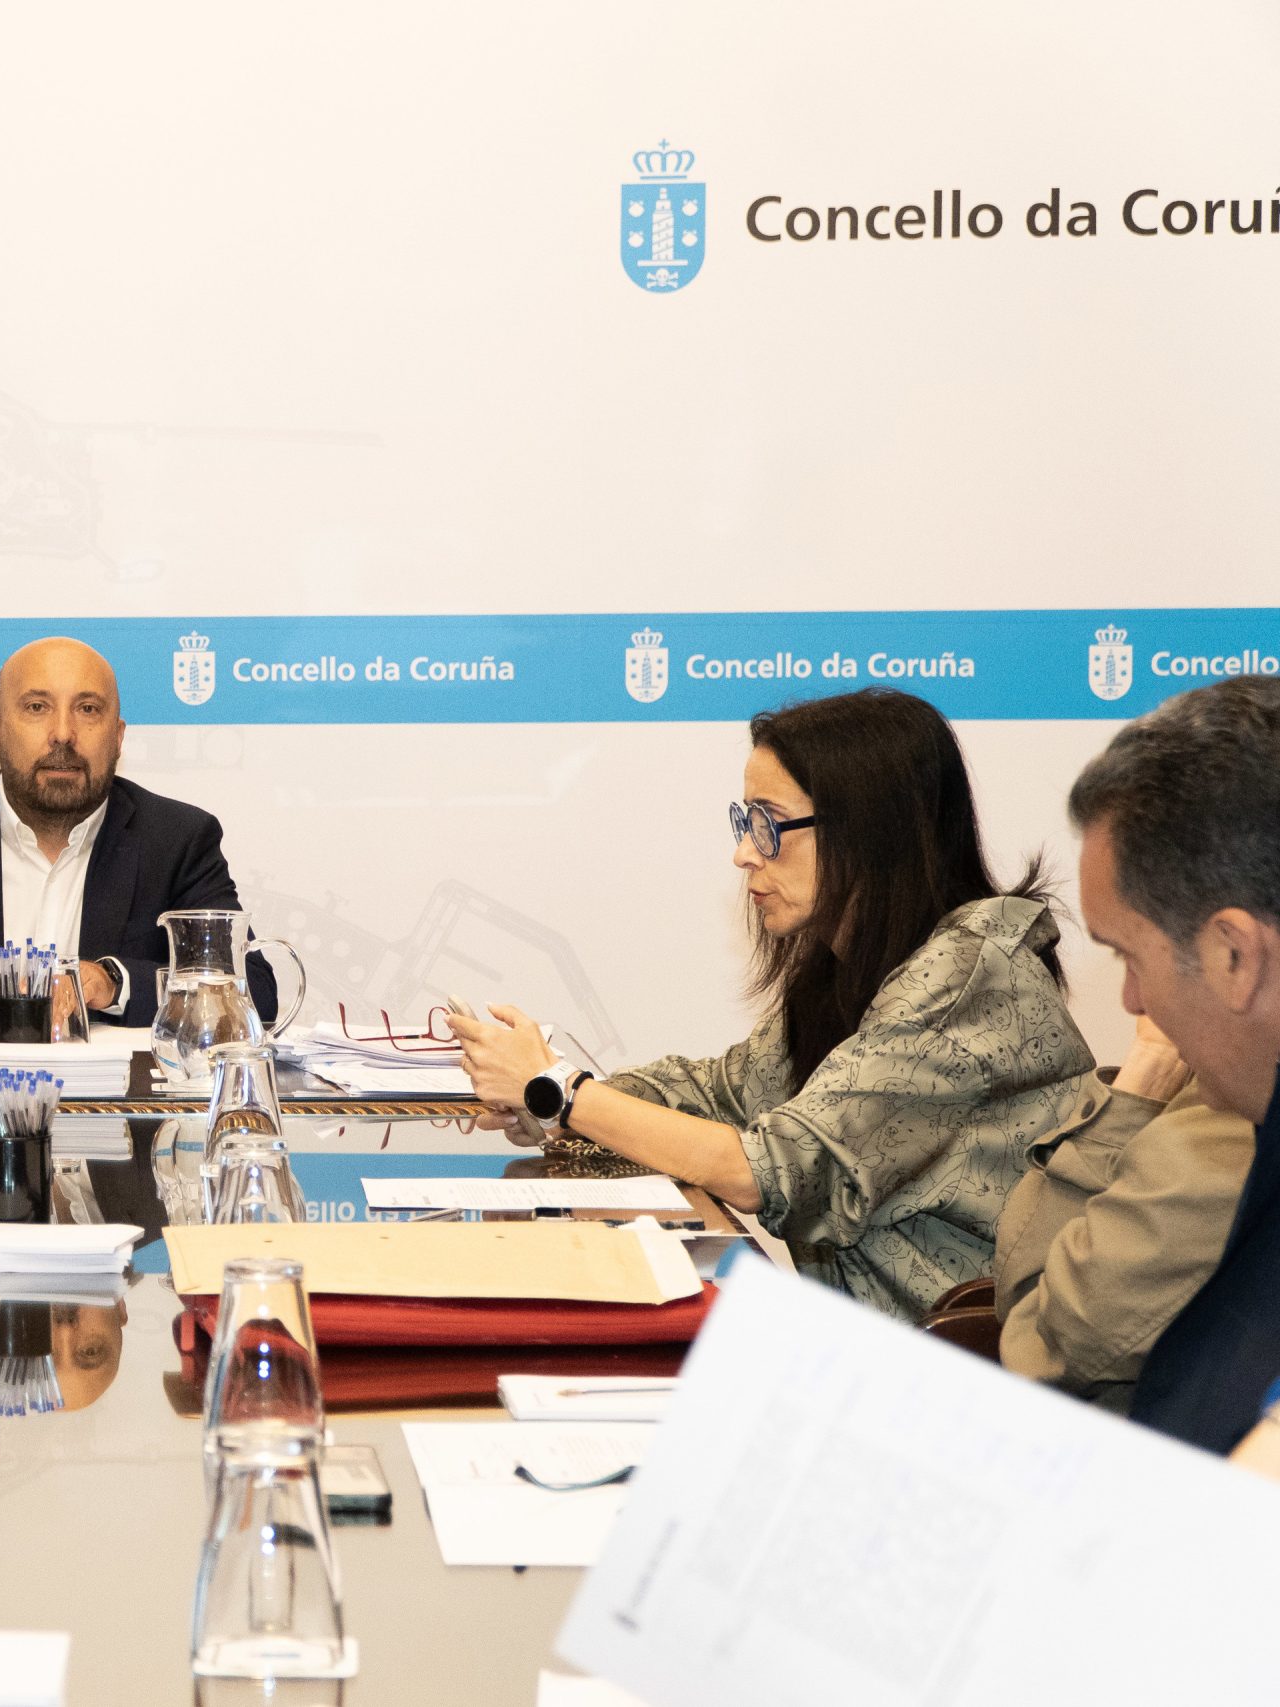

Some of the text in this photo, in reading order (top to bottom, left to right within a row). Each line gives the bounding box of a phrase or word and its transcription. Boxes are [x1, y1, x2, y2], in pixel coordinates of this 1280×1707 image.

[746, 189, 1003, 242] Concello
[1025, 187, 1097, 238] da
[232, 655, 515, 683] Concello da Coruña
[685, 652, 975, 679] Concello da Coruña
[1150, 649, 1280, 676] Concello
